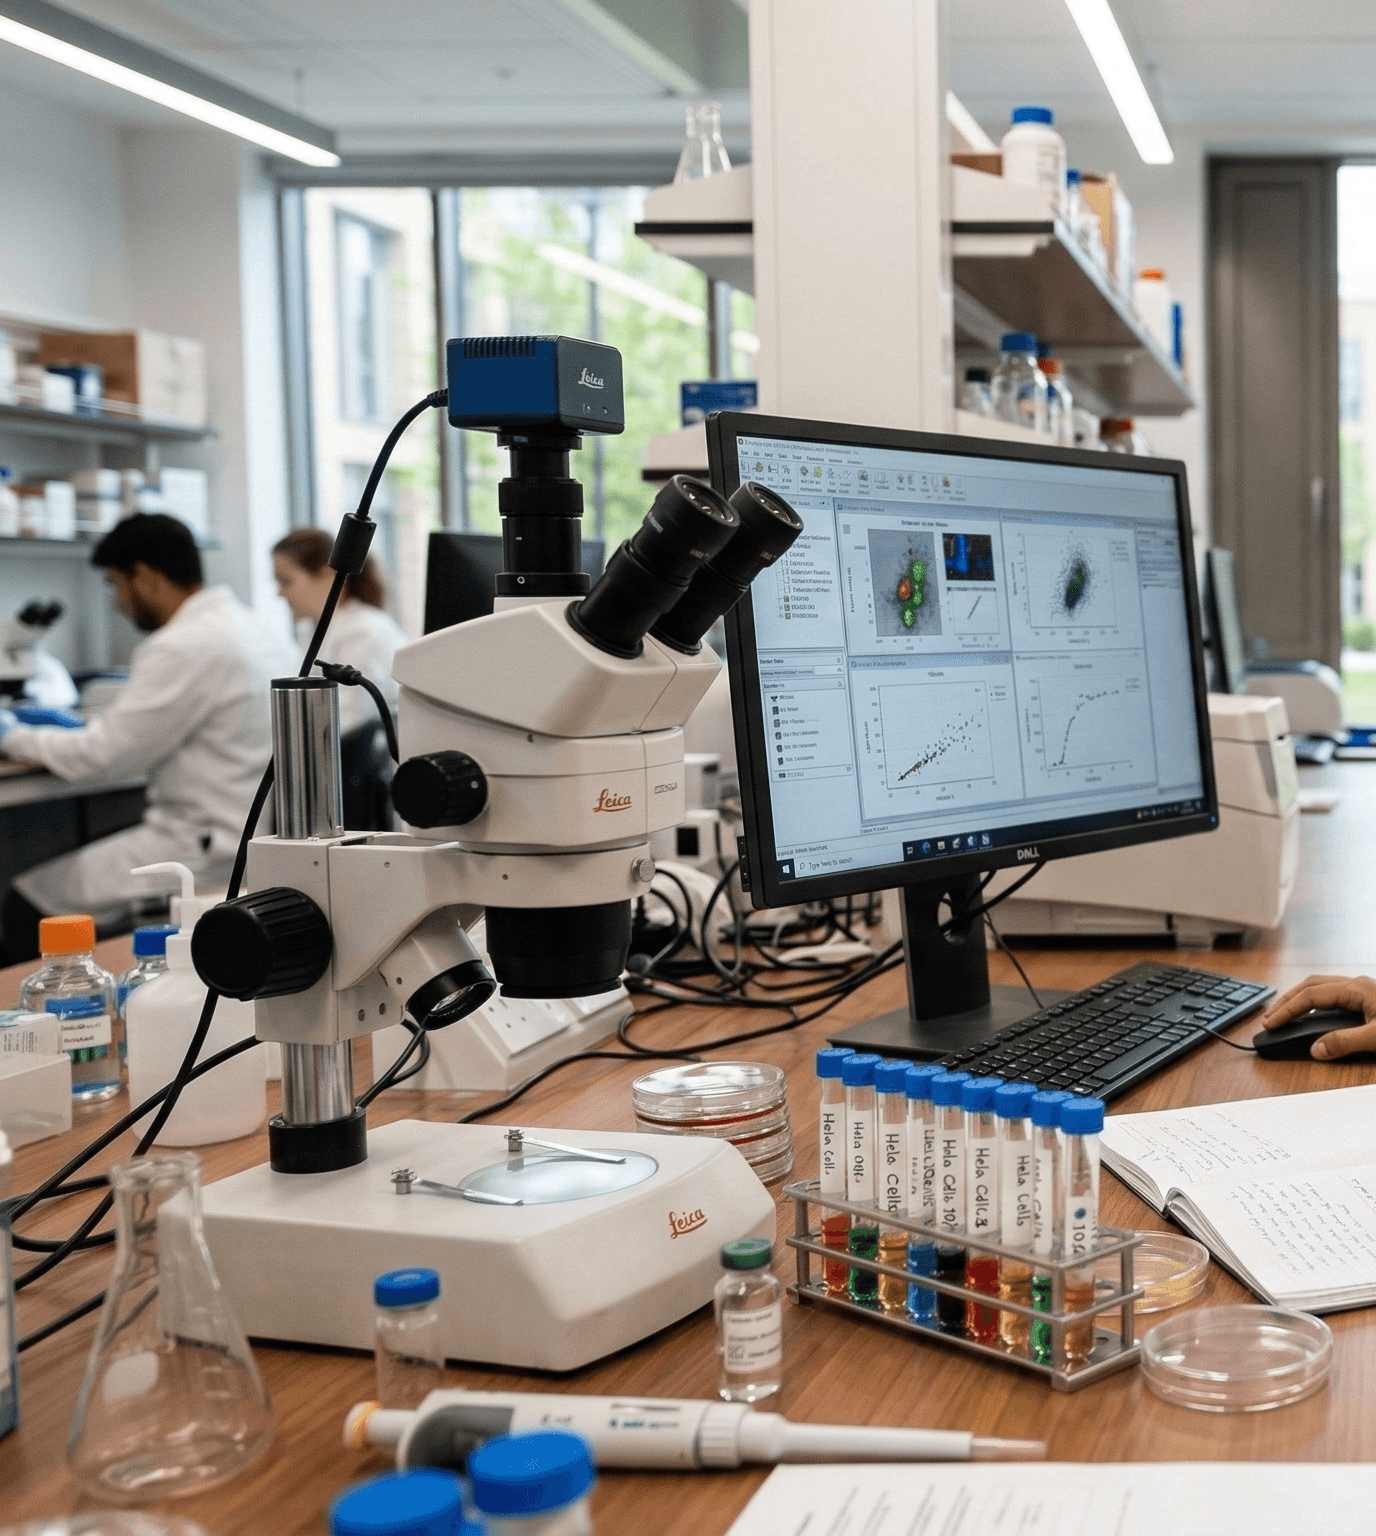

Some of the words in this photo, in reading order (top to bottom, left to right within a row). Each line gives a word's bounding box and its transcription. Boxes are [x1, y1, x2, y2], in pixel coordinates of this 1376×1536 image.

[592, 788, 632, 812] Leica
[885, 1133, 901, 1166] Hela
[975, 1147, 990, 1179] Hela
[1016, 1155, 1031, 1187] Hela
[668, 1208, 708, 1240] Leica
